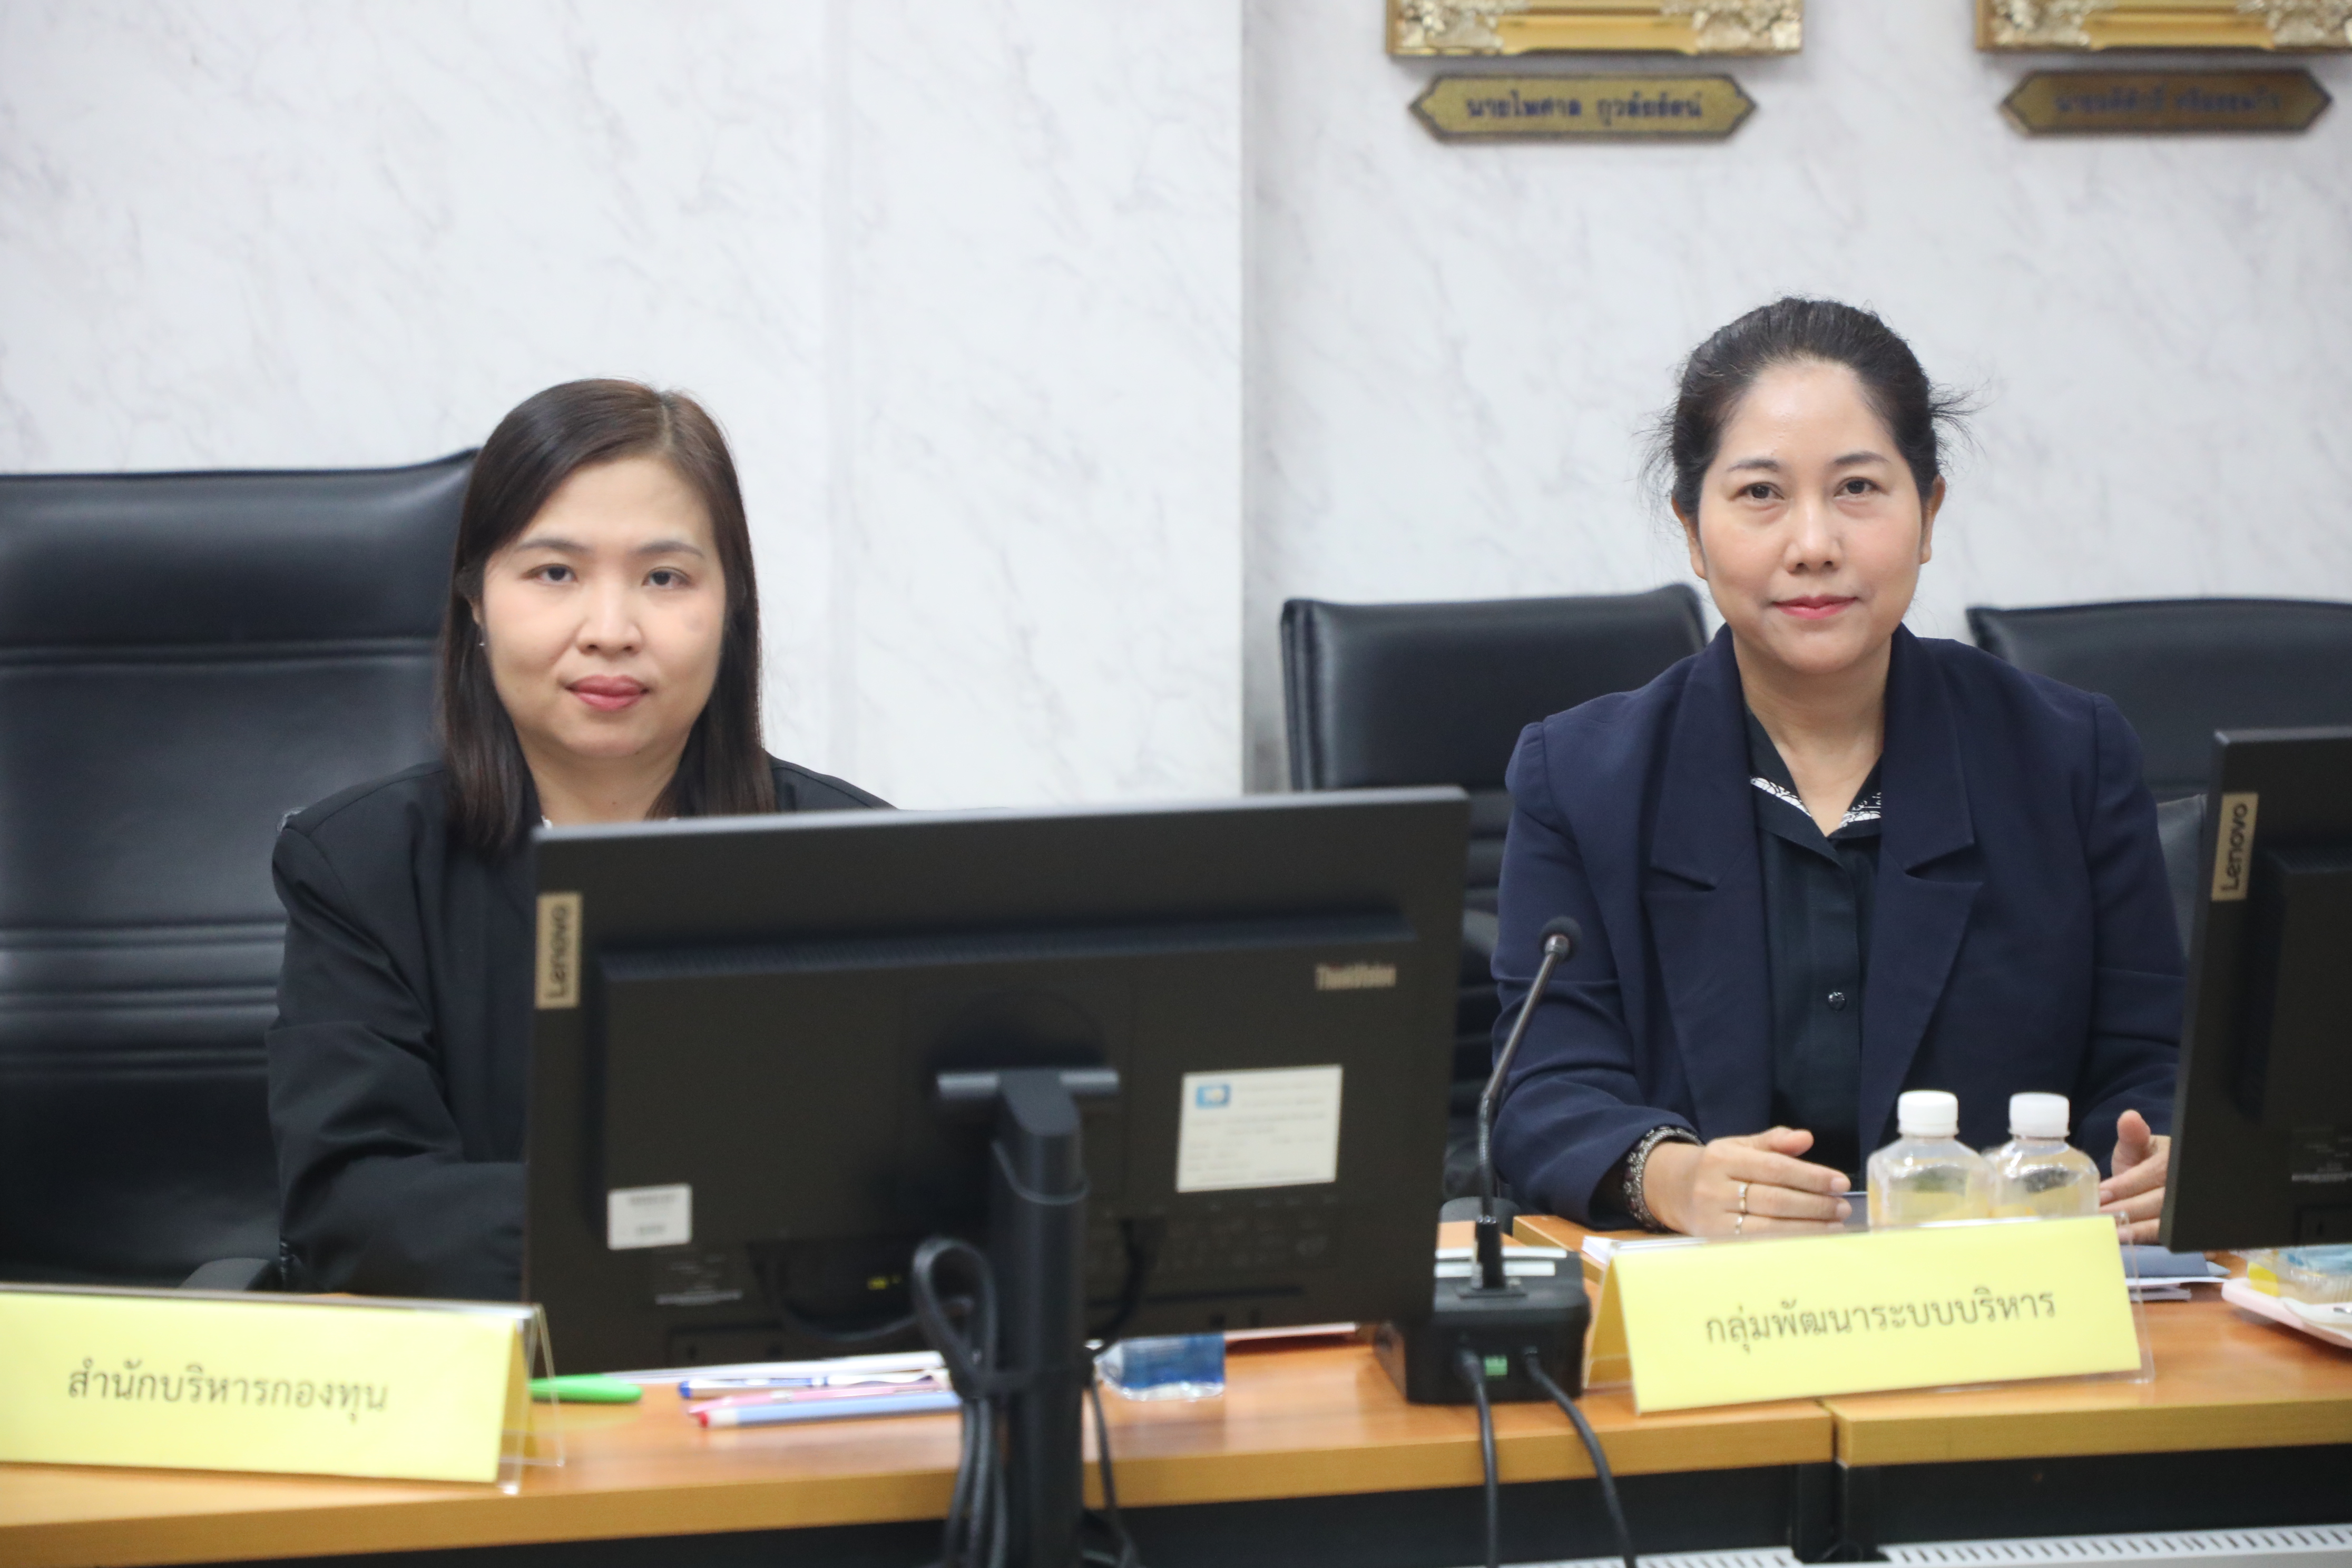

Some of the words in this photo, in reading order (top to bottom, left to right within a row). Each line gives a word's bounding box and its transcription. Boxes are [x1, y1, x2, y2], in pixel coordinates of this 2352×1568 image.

[2219, 802, 2248, 892] Lenovo
[1705, 1286, 2056, 1354] กลุ่มพัฒนาระบบบริหาร
[67, 1356, 388, 1423] สำนักบริหารกองทุน
